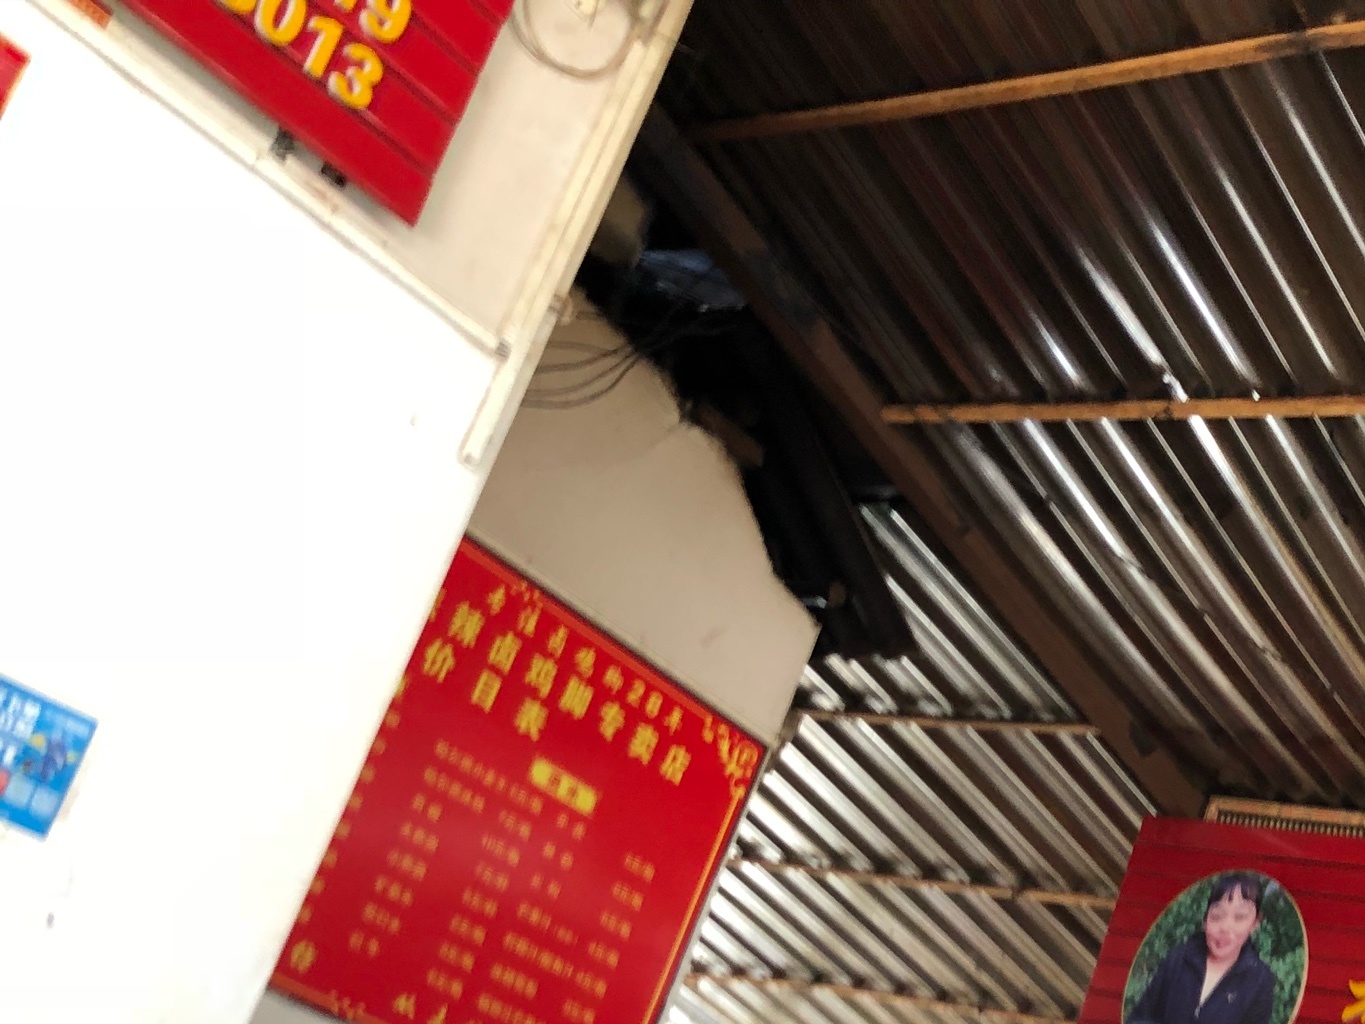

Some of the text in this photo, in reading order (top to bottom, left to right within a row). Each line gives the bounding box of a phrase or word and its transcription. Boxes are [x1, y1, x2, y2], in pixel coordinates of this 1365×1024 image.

[219, 0, 385, 110] 013
[422, 636, 550, 743] 价目表
[430, 588, 692, 787] 辣卤鸡脚专卖店
